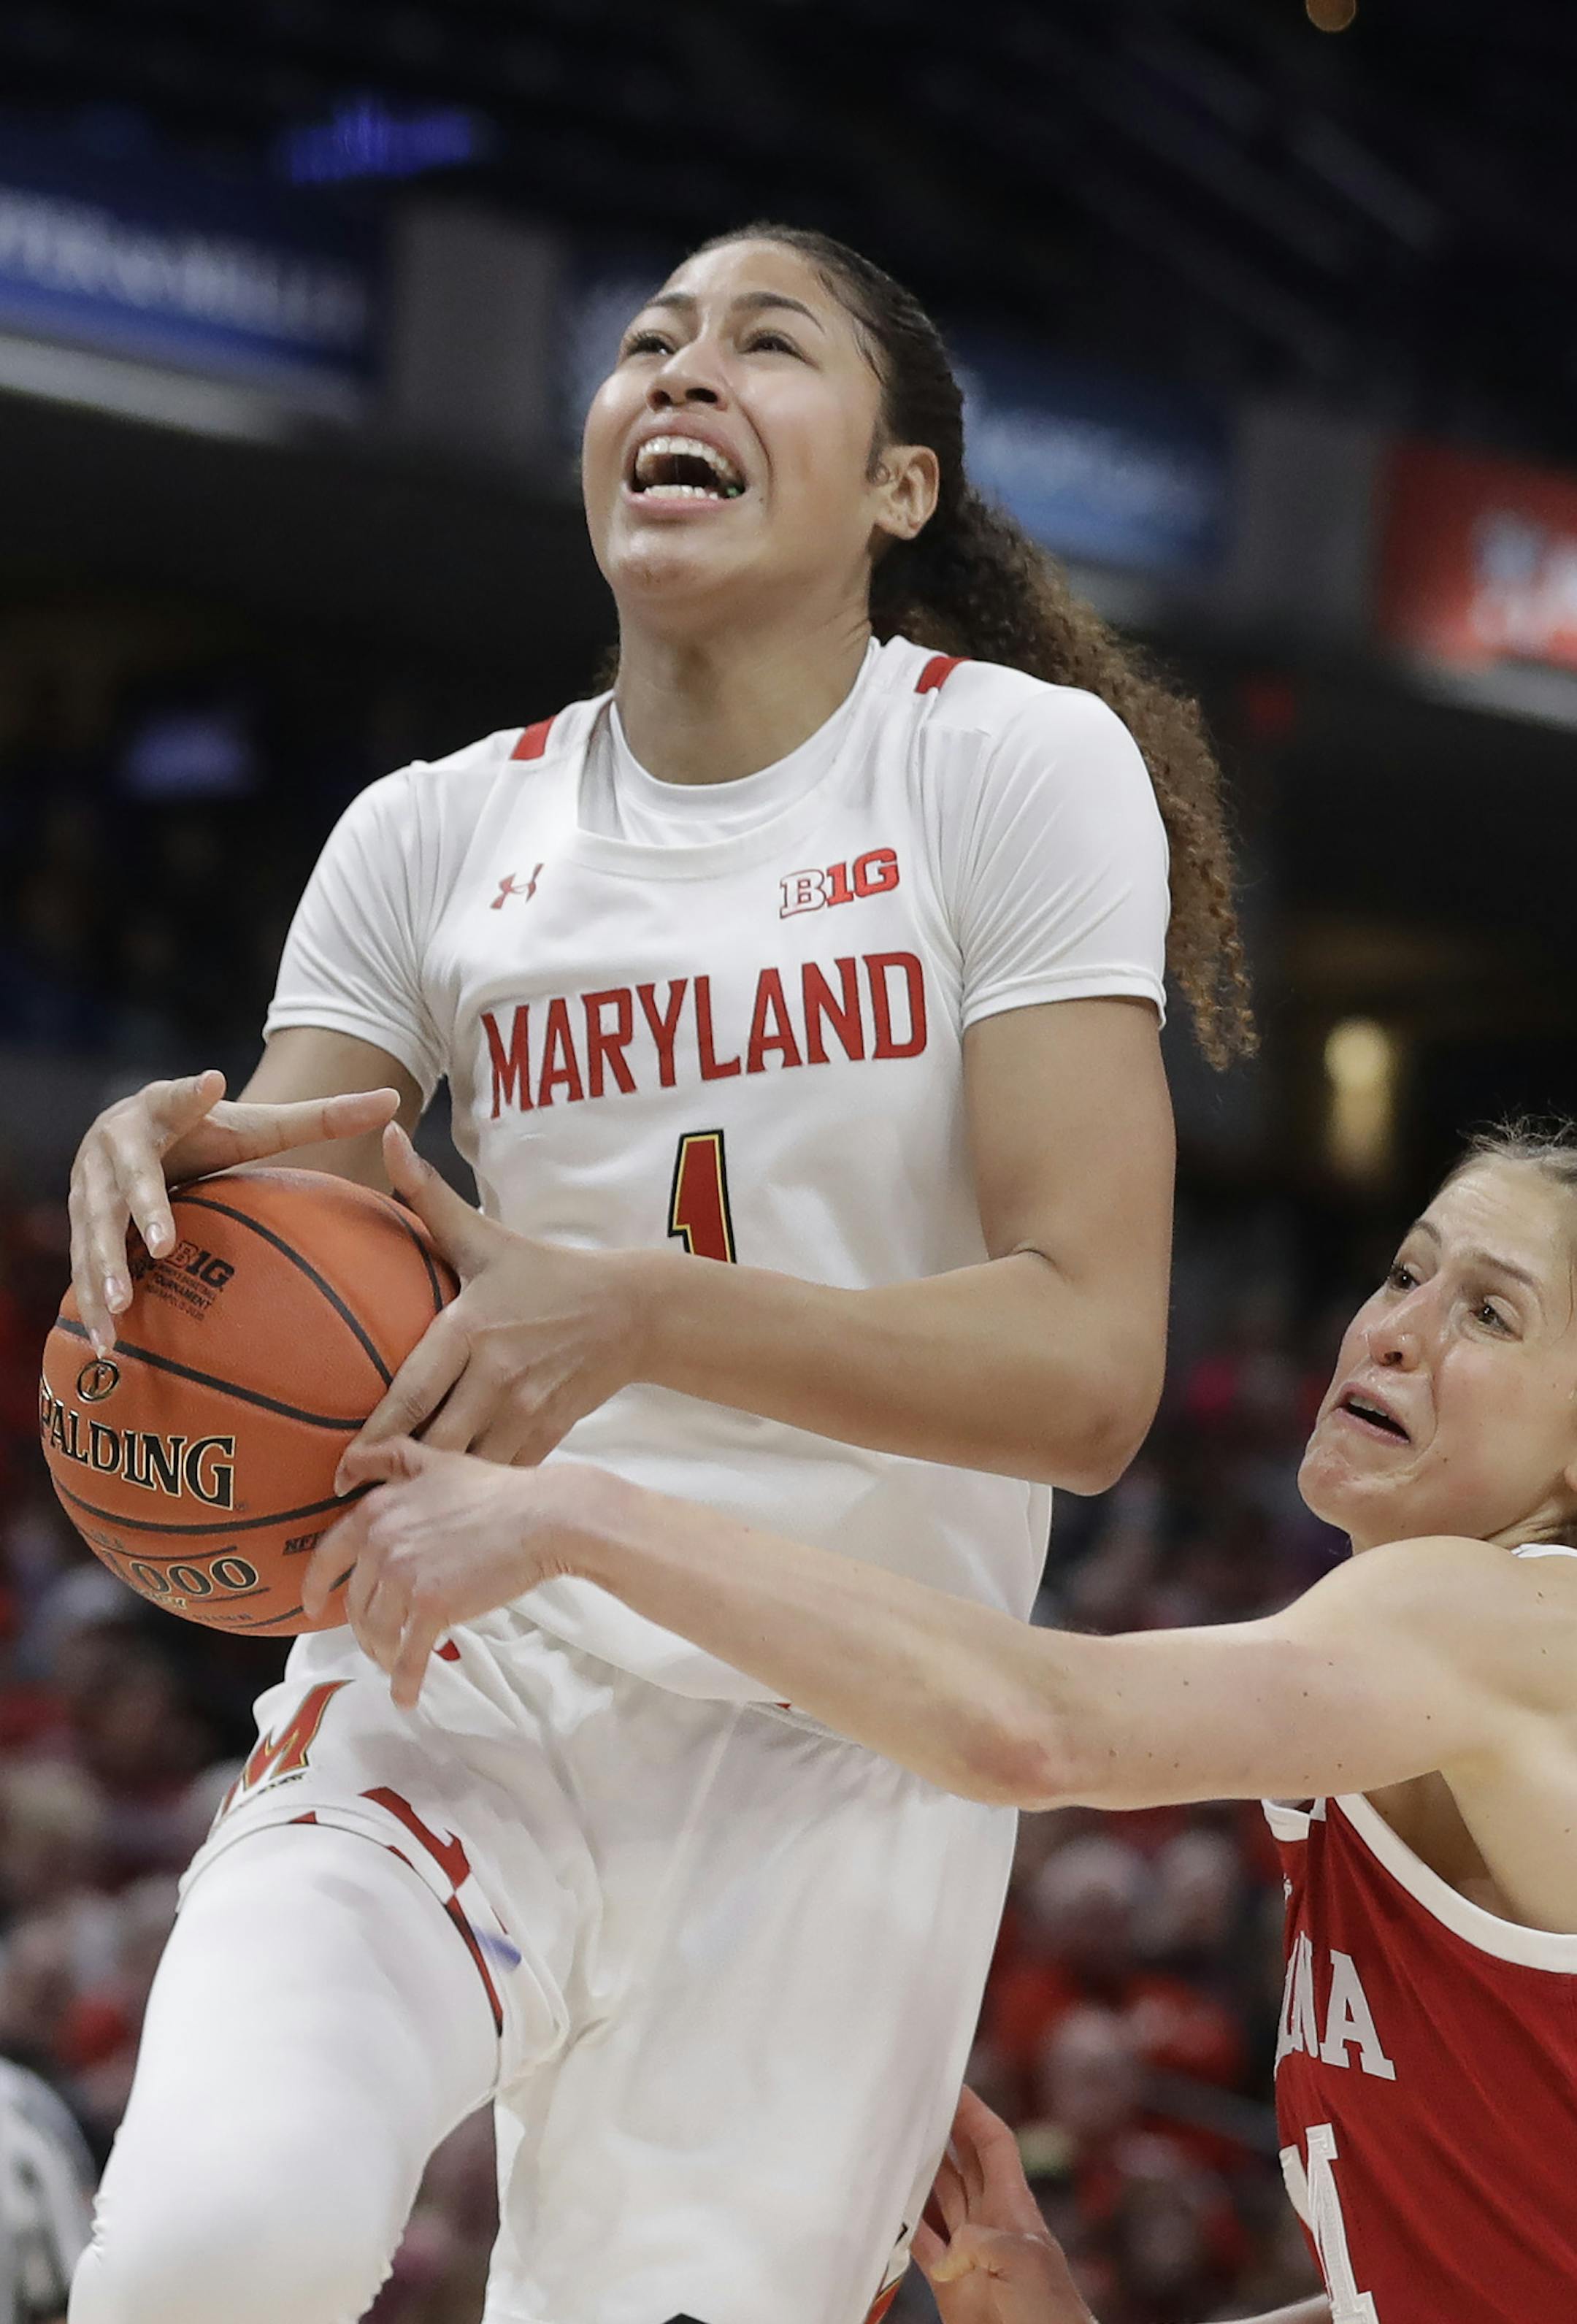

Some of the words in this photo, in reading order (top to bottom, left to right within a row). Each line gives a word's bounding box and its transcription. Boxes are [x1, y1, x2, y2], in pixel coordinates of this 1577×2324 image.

[480, 951, 928, 1121] MARYLAND
[667, 1129, 737, 1265] 1
[39, 1374, 236, 1511] PALDING
